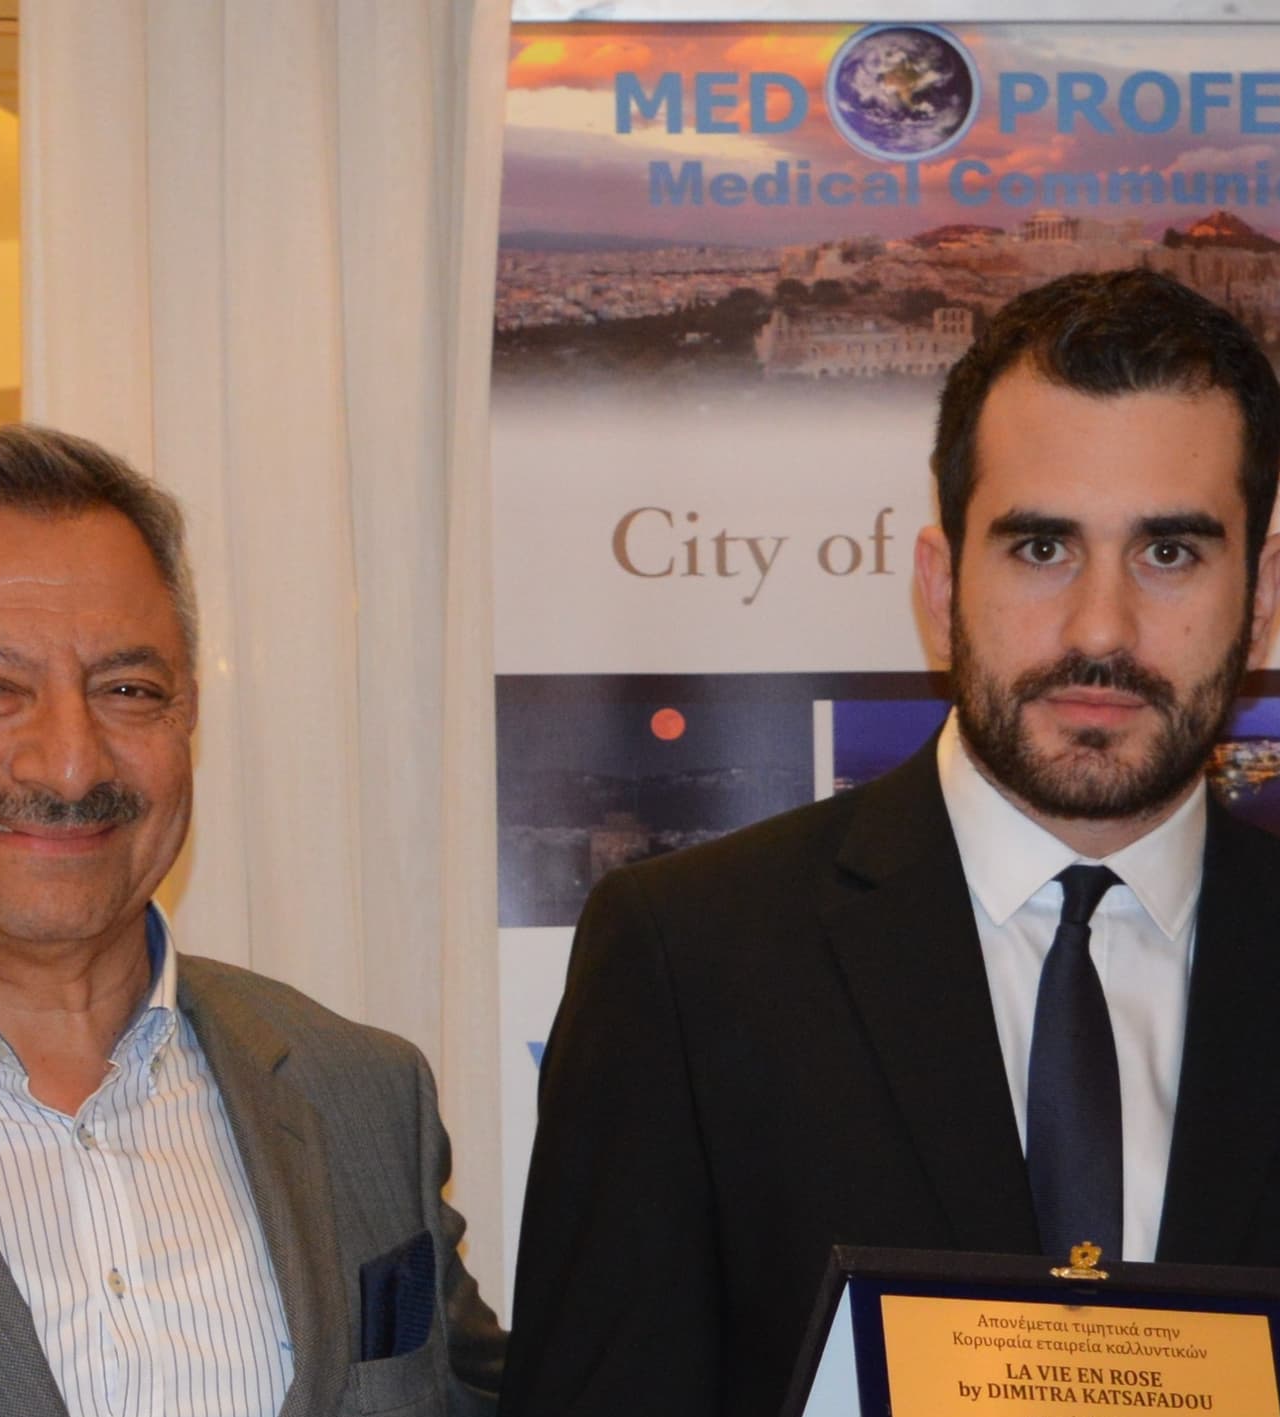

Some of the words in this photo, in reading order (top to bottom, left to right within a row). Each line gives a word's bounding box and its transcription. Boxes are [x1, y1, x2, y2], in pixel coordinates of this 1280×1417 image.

[615, 71, 809, 135] MED
[648, 159, 920, 207] Medical
[611, 506, 790, 605] City
[817, 506, 896, 577] of
[976, 1313, 1070, 1333] Απονέμεται
[1072, 1321, 1141, 1338] τιμητικά
[1143, 1325, 1181, 1342] στην
[952, 1331, 1032, 1351] Κορυφαία
[1036, 1338, 1102, 1355] εταιρεία
[1006, 1363, 1032, 1381] LA
[1037, 1364, 1072, 1383] VIE
[1077, 1367, 1104, 1385] EN
[1110, 1368, 1163, 1388] ROSE
[958, 1380, 981, 1402] by
[987, 1382, 1076, 1402] DIMITRA
[1082, 1387, 1213, 1410] KATSAFADOU
